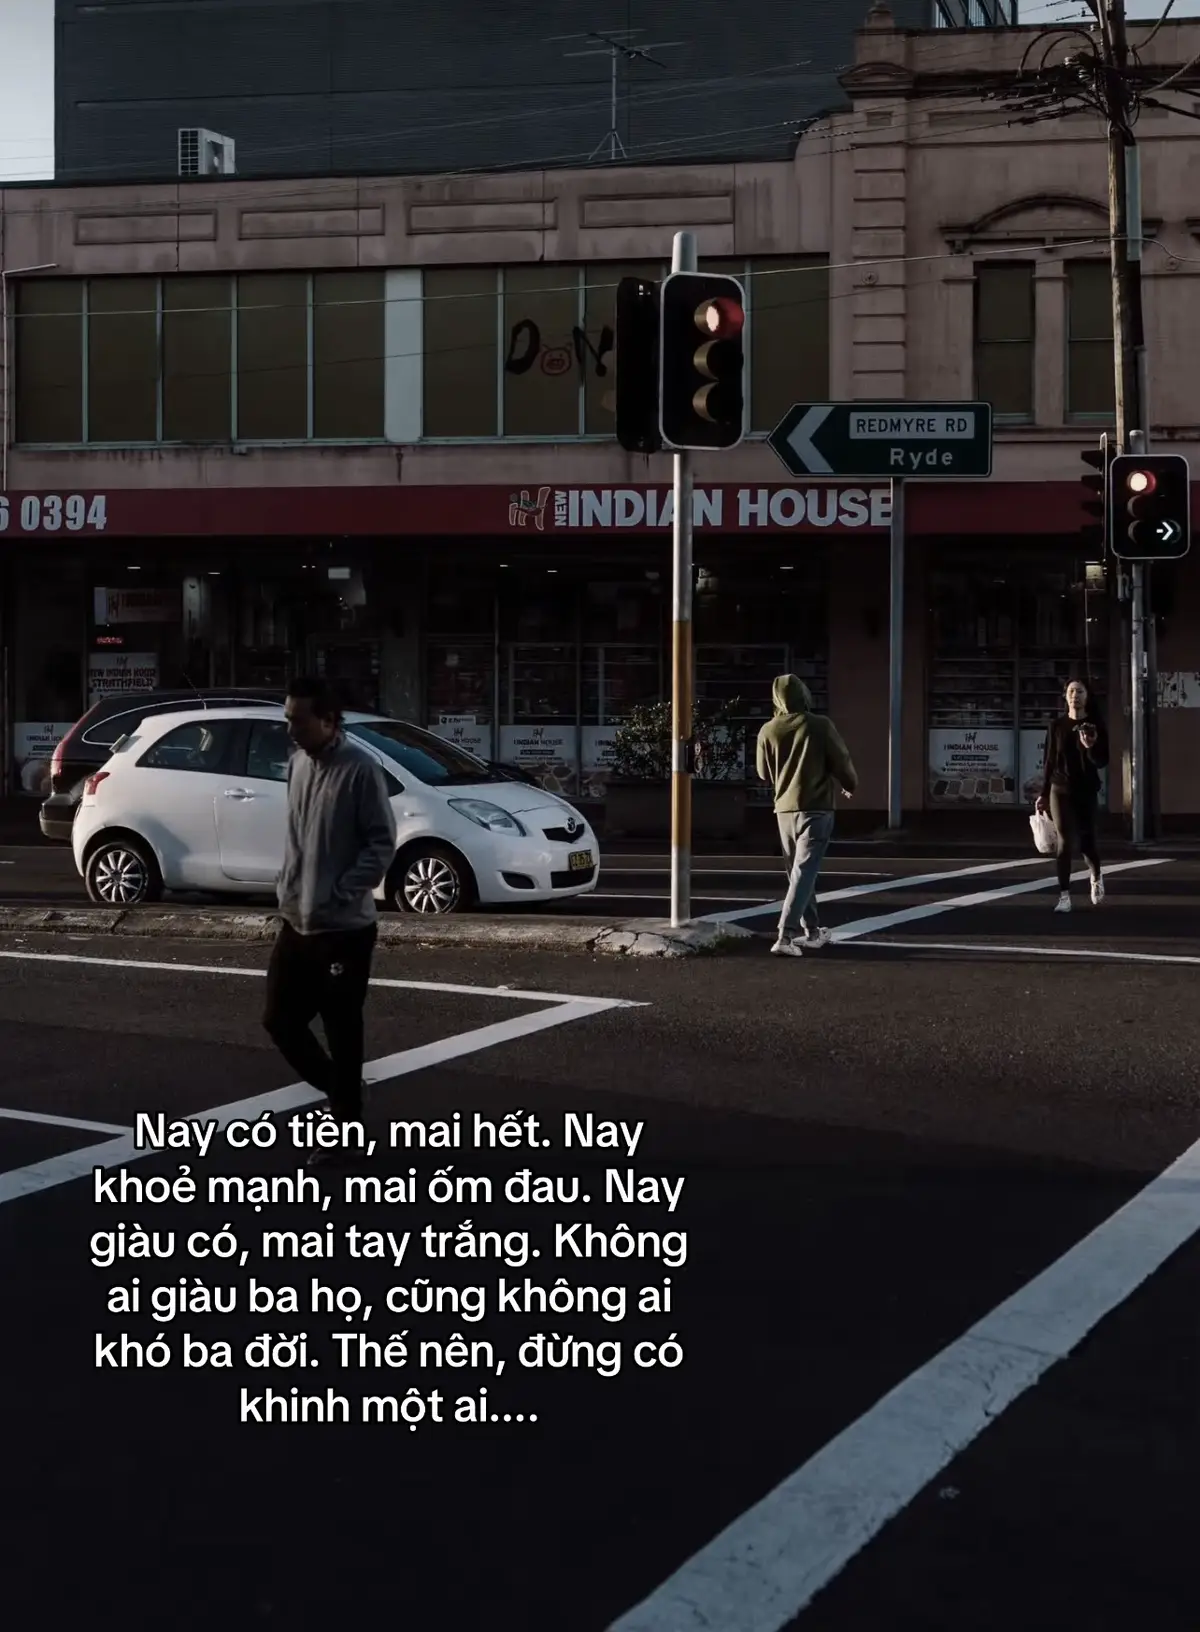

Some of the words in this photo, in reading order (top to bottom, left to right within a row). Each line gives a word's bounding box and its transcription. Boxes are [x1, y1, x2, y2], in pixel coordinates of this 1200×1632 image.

[856, 418, 936, 433] REDMYRE
[945, 418, 967, 432] RD
[889, 448, 953, 470] Ryde
[20, 494, 107, 531] 0394
[554, 490, 567, 527] NEW
[737, 488, 891, 527] HOUSE
